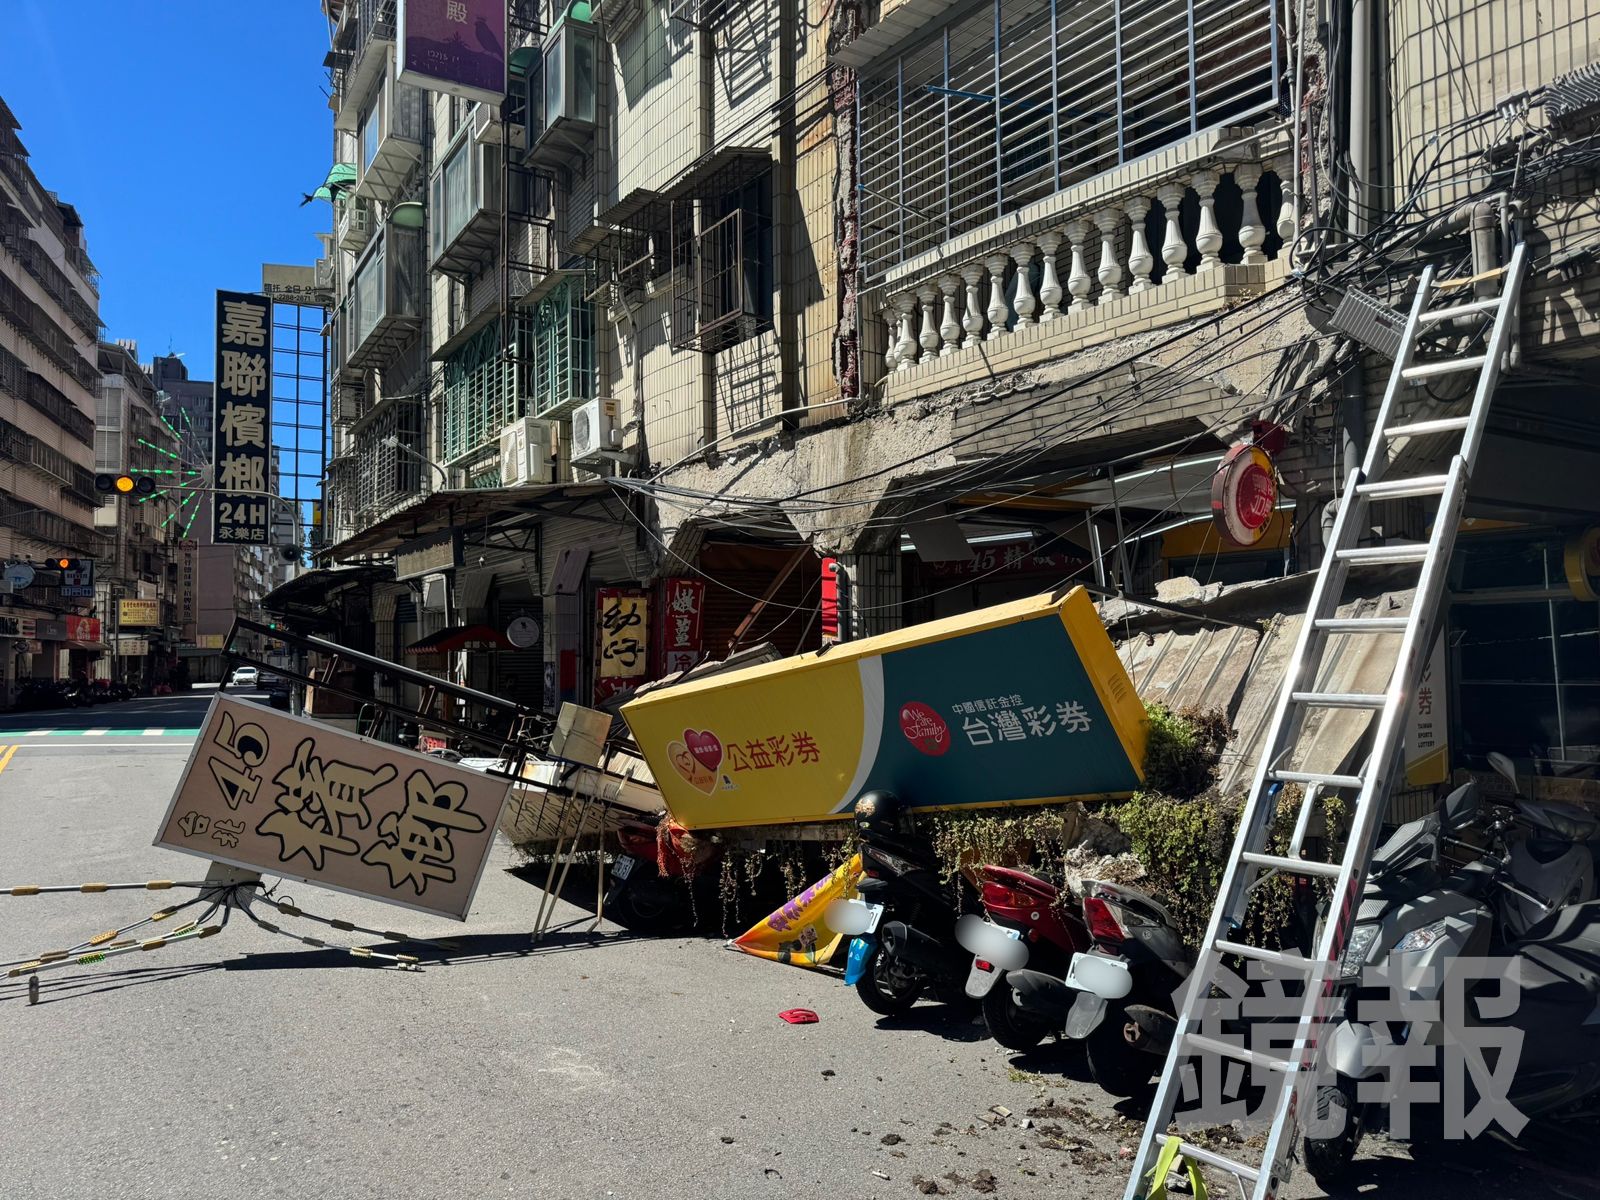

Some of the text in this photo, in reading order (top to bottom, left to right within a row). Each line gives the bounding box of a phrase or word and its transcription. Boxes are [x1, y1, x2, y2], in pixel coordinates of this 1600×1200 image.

[220, 301, 266, 498] 嘉聯檳榔
[218, 526, 265, 541] 永樂店
[219, 504, 265, 524] 24H
[951, 693, 1025, 715] 中國信託金控
[962, 700, 1093, 746] 台灣彩券
[209, 710, 270, 810] 45
[726, 730, 821, 772] 公益彩券
[177, 810, 246, 849] 台北
[255, 736, 488, 896] 檳榔
